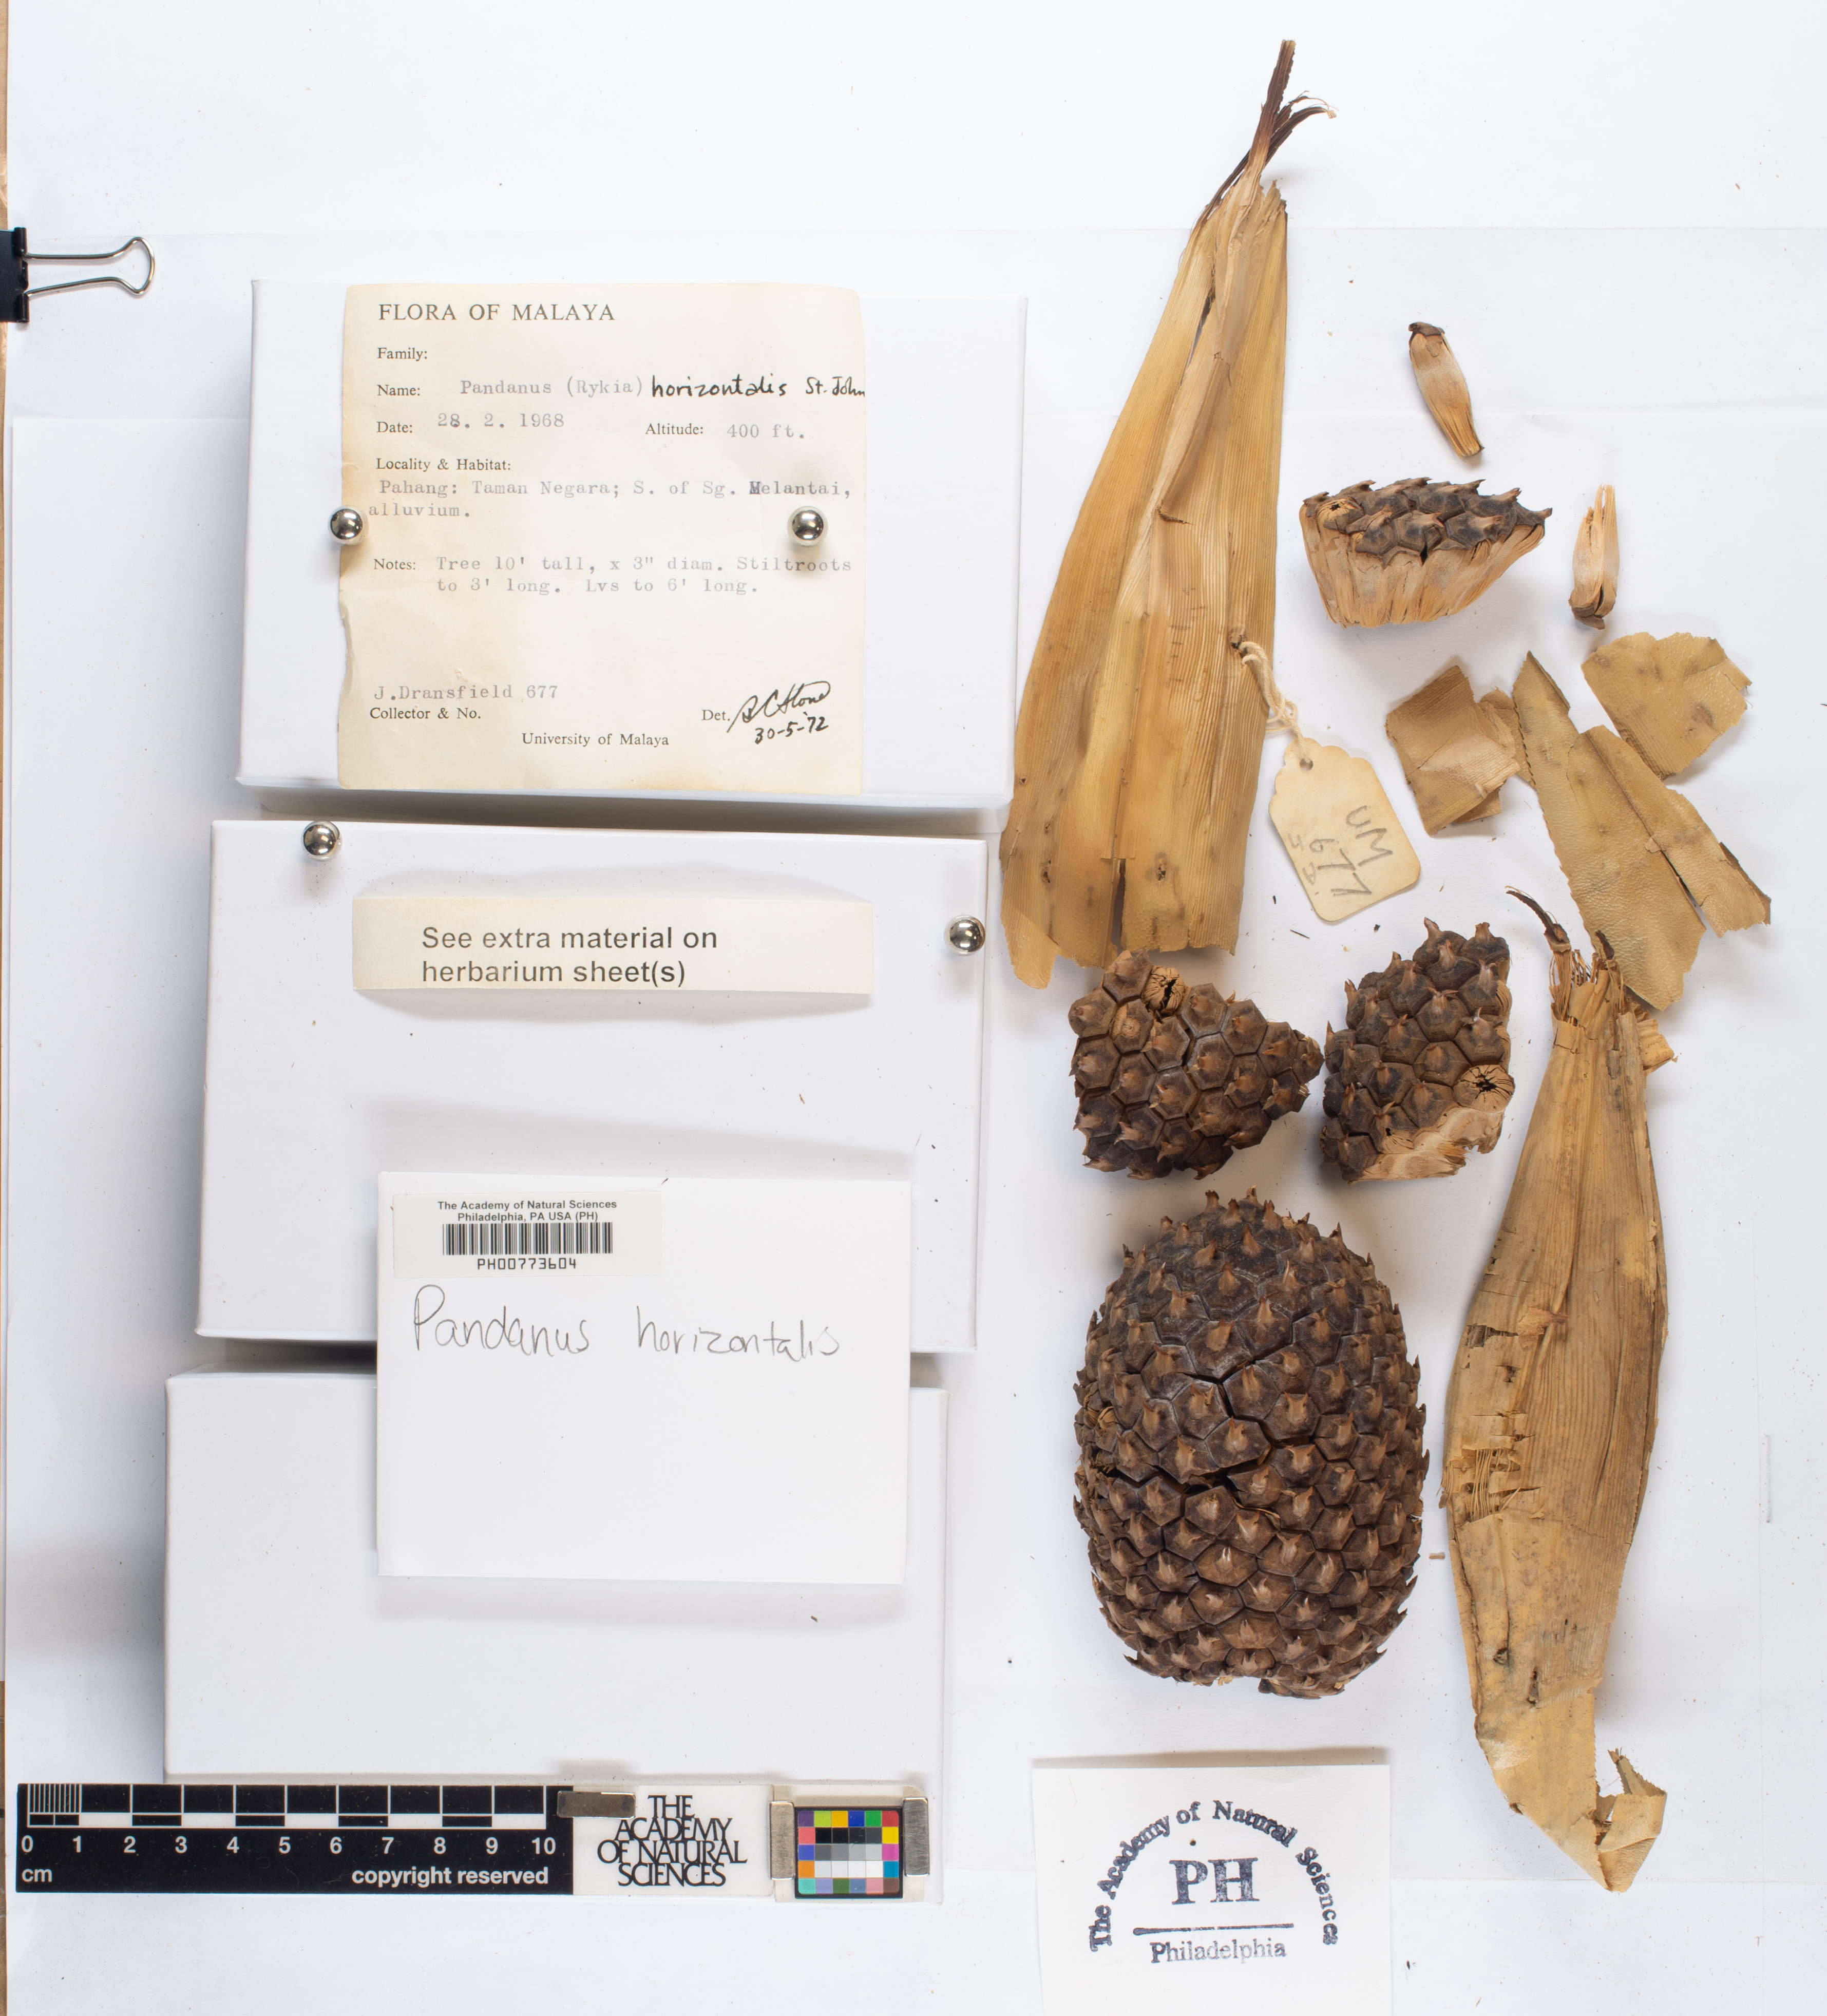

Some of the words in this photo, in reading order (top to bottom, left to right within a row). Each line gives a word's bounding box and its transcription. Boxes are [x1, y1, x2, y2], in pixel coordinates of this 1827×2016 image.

[378, 304, 457, 321] FLORA
[469, 304, 500, 321] OF
[511, 304, 615, 321] MALAYA
[377, 347, 428, 361] Family:
[377, 384, 421, 396] Name:
[460, 380, 552, 394] Pandanus
[566, 375, 642, 397] (Rykia)
[652, 373, 787, 397] horizontalis
[805, 376, 827, 395] St.
[832, 376, 865, 397] John
[377, 421, 413, 433] Date:
[437, 412, 470, 429] 28.
[484, 413, 505, 429] 2.
[519, 413, 564, 428] 1968
[645, 423, 703, 435] Altitude:
[727, 424, 759, 438] 400
[772, 424, 805, 439] ft.
[376, 459, 431, 472] Locality
[437, 460, 449, 470] &
[456, 459, 511, 471] Habitat:
[379, 480, 457, 498] Pahang:
[472, 481, 528, 495] Taman
[540, 481, 619, 498] Negara;
[633, 480, 654, 495] S.
[669, 481, 690, 495] of
[703, 481, 736, 499] Sg.
[750, 481, 850, 499] Melantai,
[369, 504, 470, 518] alluvium.
[373, 558, 416, 570] Notes:
[437, 557, 481, 570] Tree
[542, 556, 595, 575] tall,
[610, 560, 621, 570] x
[668, 557, 723, 571] diam.
[737, 557, 851, 572] Stiltroots
[438, 578, 457, 592] to
[471, 578, 490, 592] 3'
[506, 578, 561, 596] long.
[586, 579, 620, 592] Lvs
[633, 579, 653, 592] to
[668, 579, 687, 592] 6'
[704, 579, 757, 595] long.
[374, 685, 513, 701] J.Dransfield
[526, 685, 558, 699] 677
[370, 708, 431, 719] Collector
[437, 708, 449, 719] &
[456, 708, 481, 719] No.
[701, 709, 730, 721] Det.
[522, 733, 591, 747] University
[598, 734, 613, 745] of
[619, 734, 669, 747] Malaya
[423, 926, 472, 948] See
[483, 927, 550, 948] extra
[561, 926, 672, 949] material
[683, 931, 717, 948] on
[423, 961, 562, 982] herbarium
[573, 961, 685, 987] sheet(s)
[438, 1201, 458, 1210] The
[461, 1201, 510, 1212] Academy
[513, 1201, 524, 1209] of
[527, 1200, 565, 1209] Natural
[569, 1200, 617, 1209] Sciences
[458, 1212, 526, 1223] Philadelphia,
[530, 1212, 545, 1221] PA
[548, 1212, 572, 1220] USA
[575, 1211, 598, 1222] (PH)
[477, 1258, 577, 1270] PH00773604
[414, 1284, 589, 1356] Pandanus
[637, 1305, 840, 1362] horizontalis
[648, 1795, 695, 1818] THE
[1176, 1801, 1201, 1824] of
[613, 1817, 733, 1841] ACADEMY
[1212, 1800, 1298, 1848] Natural
[22, 1835, 33, 1853] 0
[73, 1836, 82, 1853] 1
[124, 1836, 136, 1853] 2
[175, 1836, 187, 1853] 3
[227, 1837, 239, 1853] 4
[279, 1837, 291, 1854] 5
[330, 1837, 342, 1854] 6
[382, 1837, 394, 1854] 7
[434, 1837, 446, 1854] 8
[486, 1837, 498, 1854] 9
[531, 1837, 556, 1855] 10
[597, 1839, 629, 1864] OF
[637, 1840, 748, 1865] NATURAL
[1097, 1815, 1170, 1900] Academy
[22, 1868, 52, 1882] cm
[352, 1866, 451, 1888] copyright
[458, 1867, 549, 1885] reserved
[618, 1862, 726, 1887] SCIENCES
[1169, 1857, 1260, 1905] PH
[1089, 1905, 1112, 1952] The
[1150, 1937, 1286, 1964] Philadelphia
